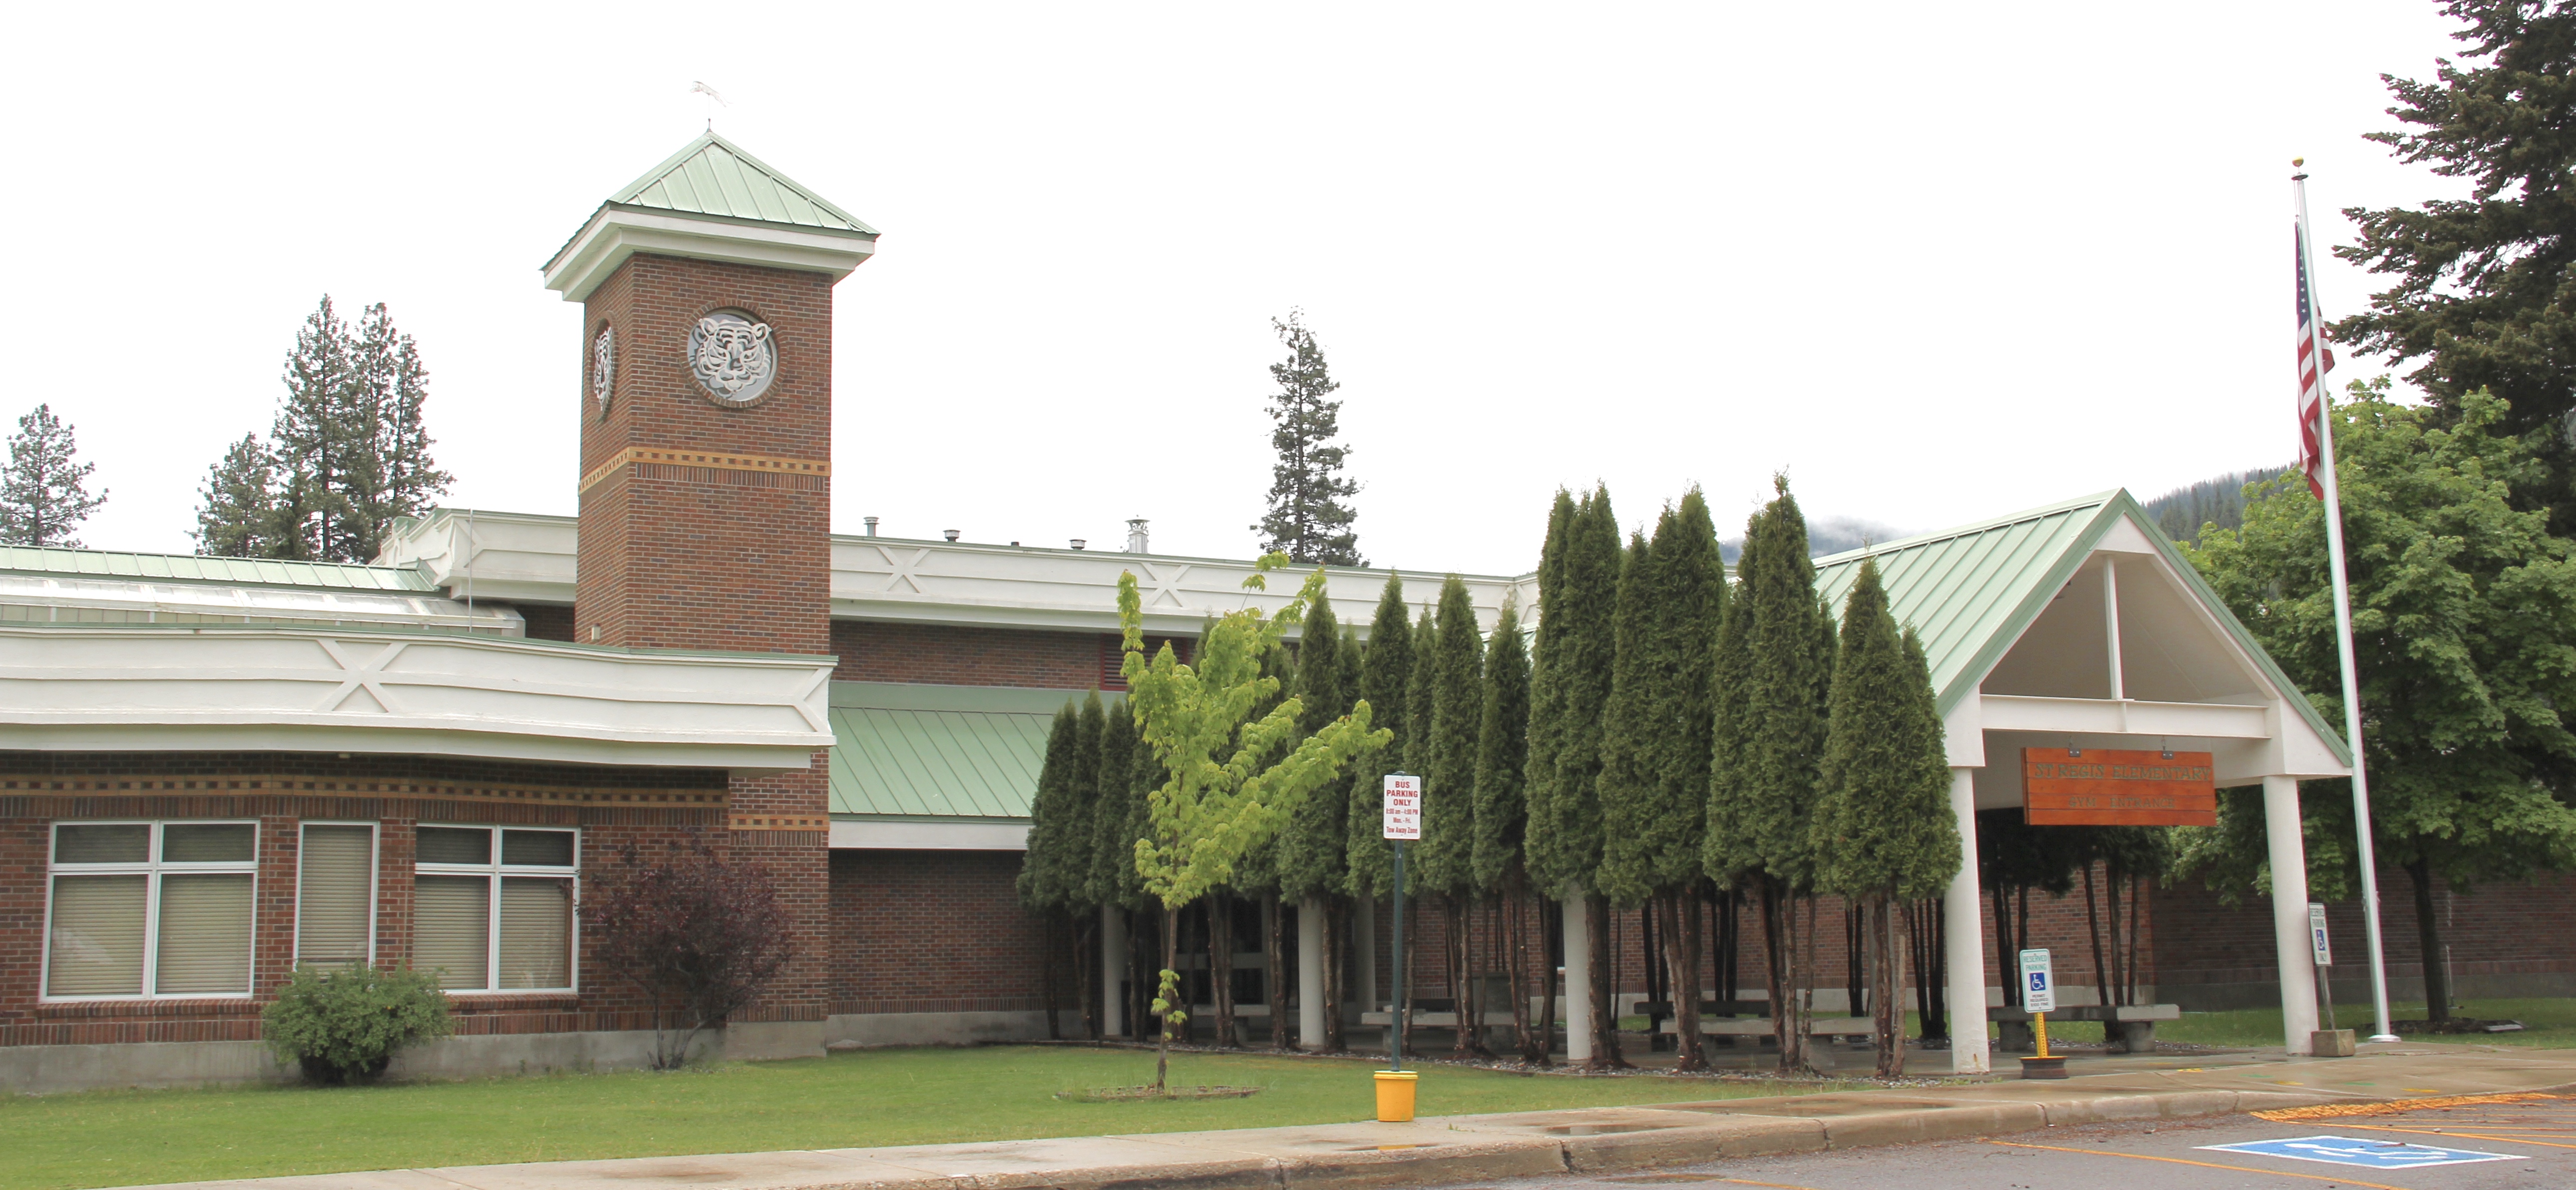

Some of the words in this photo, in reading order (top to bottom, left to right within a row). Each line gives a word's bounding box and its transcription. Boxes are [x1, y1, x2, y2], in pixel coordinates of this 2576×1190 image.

[2035, 764, 2054, 778] ST
[2058, 764, 2104, 779] REGIS
[2112, 766, 2211, 780] ELEMENTARY
[2069, 796, 2096, 807] GYM
[2110, 798, 2175, 808] ENTRANCE
